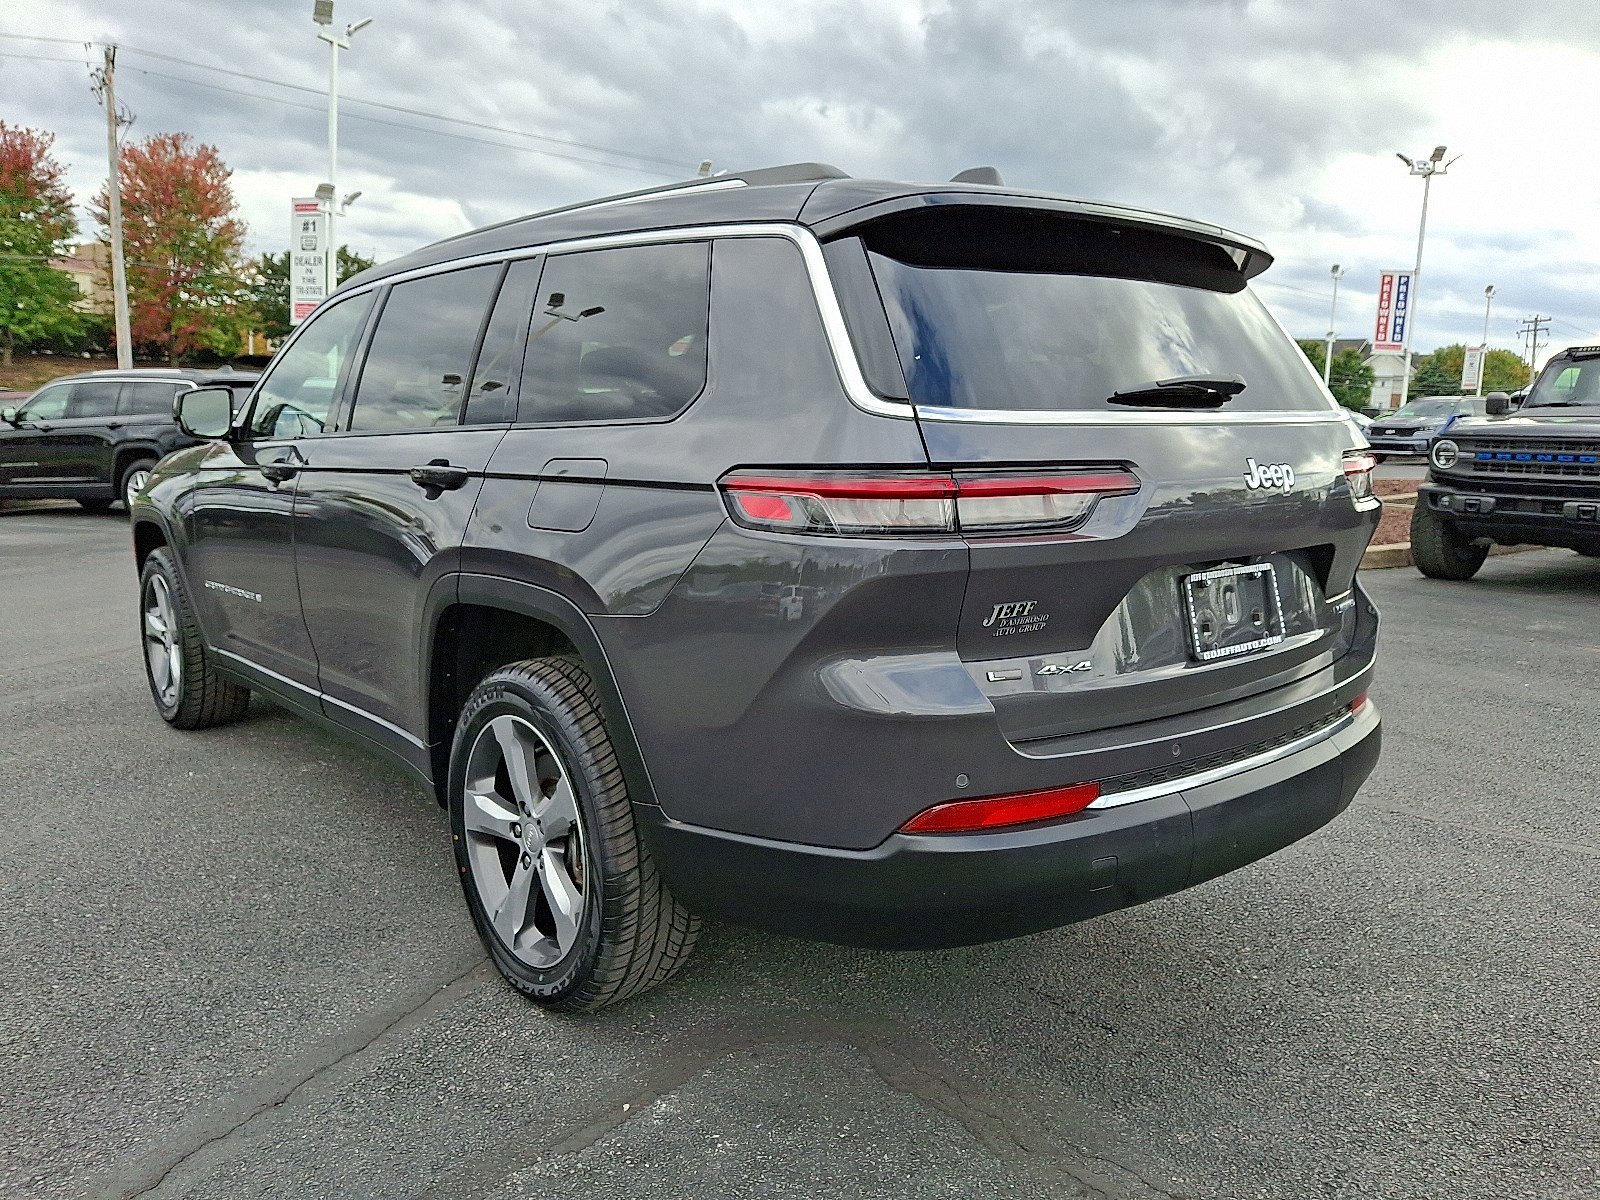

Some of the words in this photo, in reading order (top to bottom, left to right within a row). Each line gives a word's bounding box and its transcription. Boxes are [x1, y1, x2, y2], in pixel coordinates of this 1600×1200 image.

[302, 219, 316, 232] #1
[294, 255, 323, 267] DEALER
[1378, 275, 1392, 341] PREOWNED
[1394, 276, 1408, 341] PREOWNED
[1476, 452, 1598, 463] BRONCO
[1243, 457, 1295, 495] Jeep
[982, 600, 1038, 627] JEFF
[992, 627, 1016, 637] AUTO
[1018, 622, 1047, 634] GROUP
[1203, 635, 1283, 661] GOJEFFAUTO.COM
